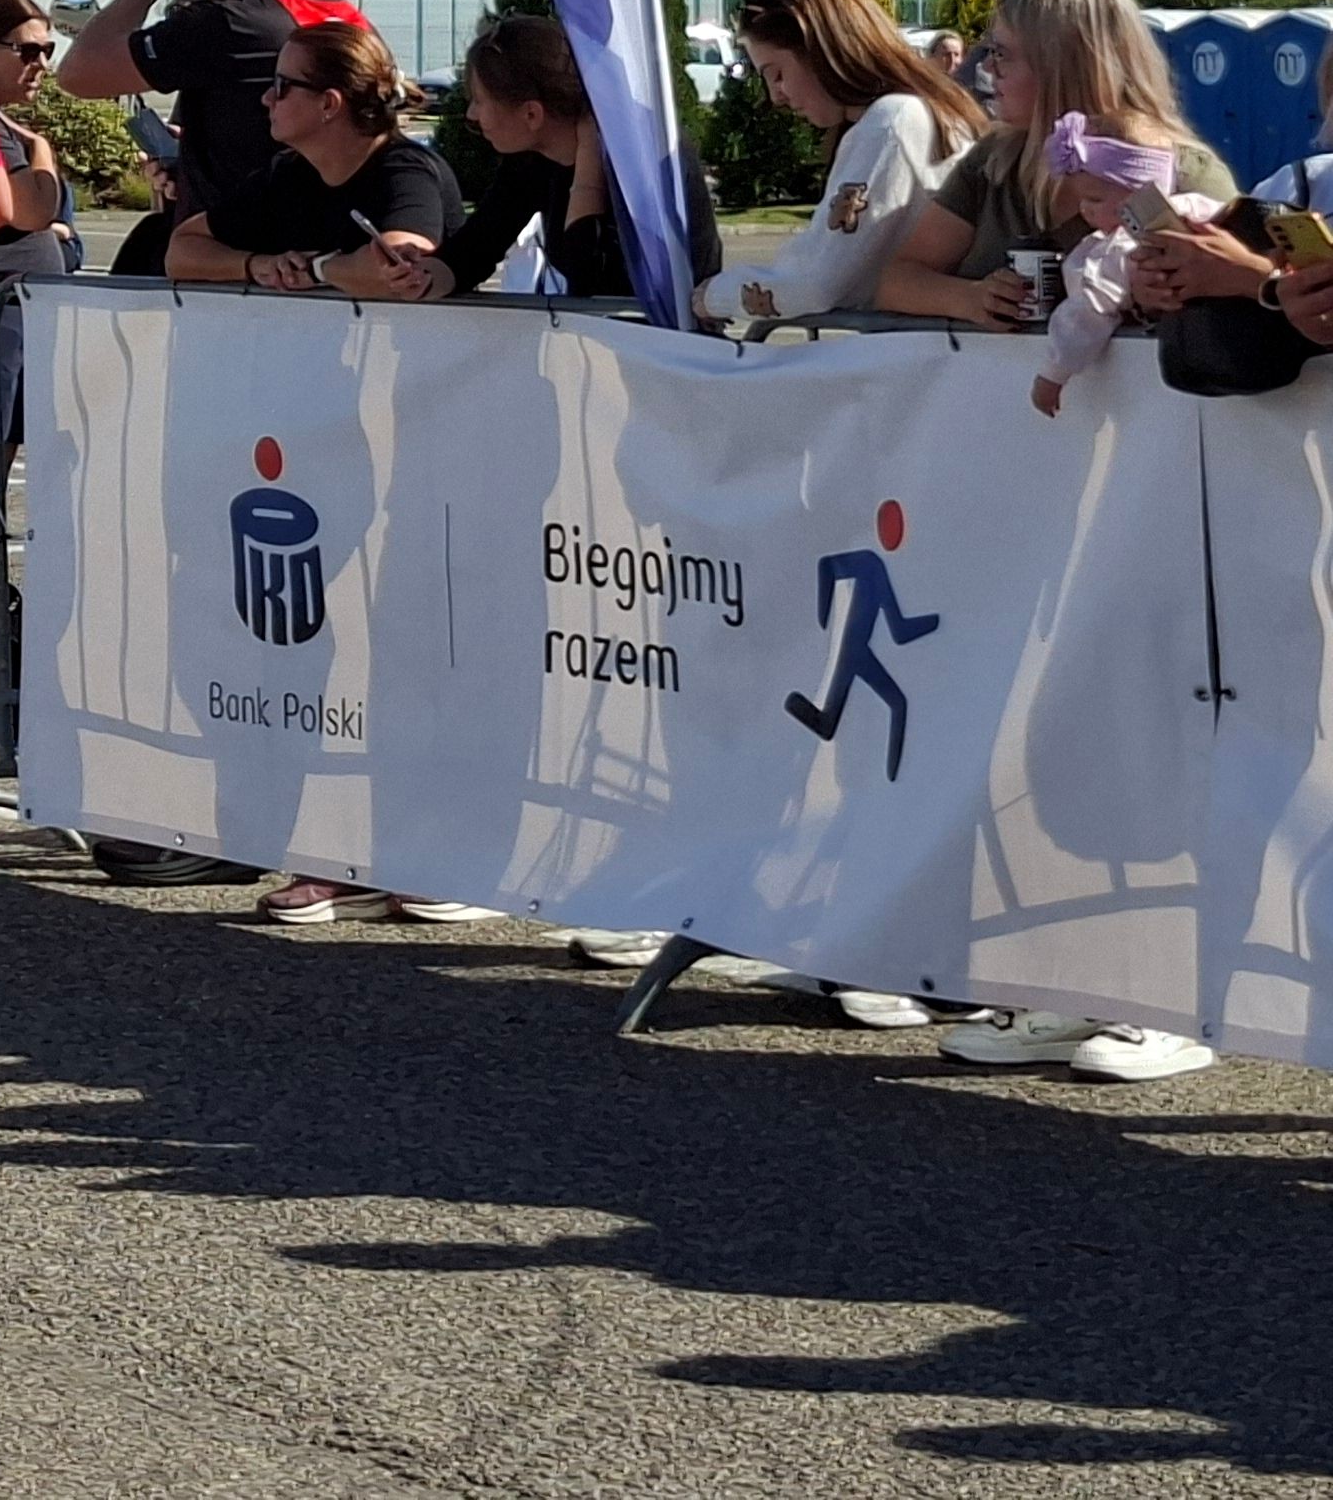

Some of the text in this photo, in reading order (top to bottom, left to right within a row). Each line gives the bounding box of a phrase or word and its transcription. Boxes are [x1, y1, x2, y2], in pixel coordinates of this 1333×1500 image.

[543, 523, 744, 627] Biegajmy
[544, 630, 679, 692] razem
[209, 681, 363, 741] Bank Polski
